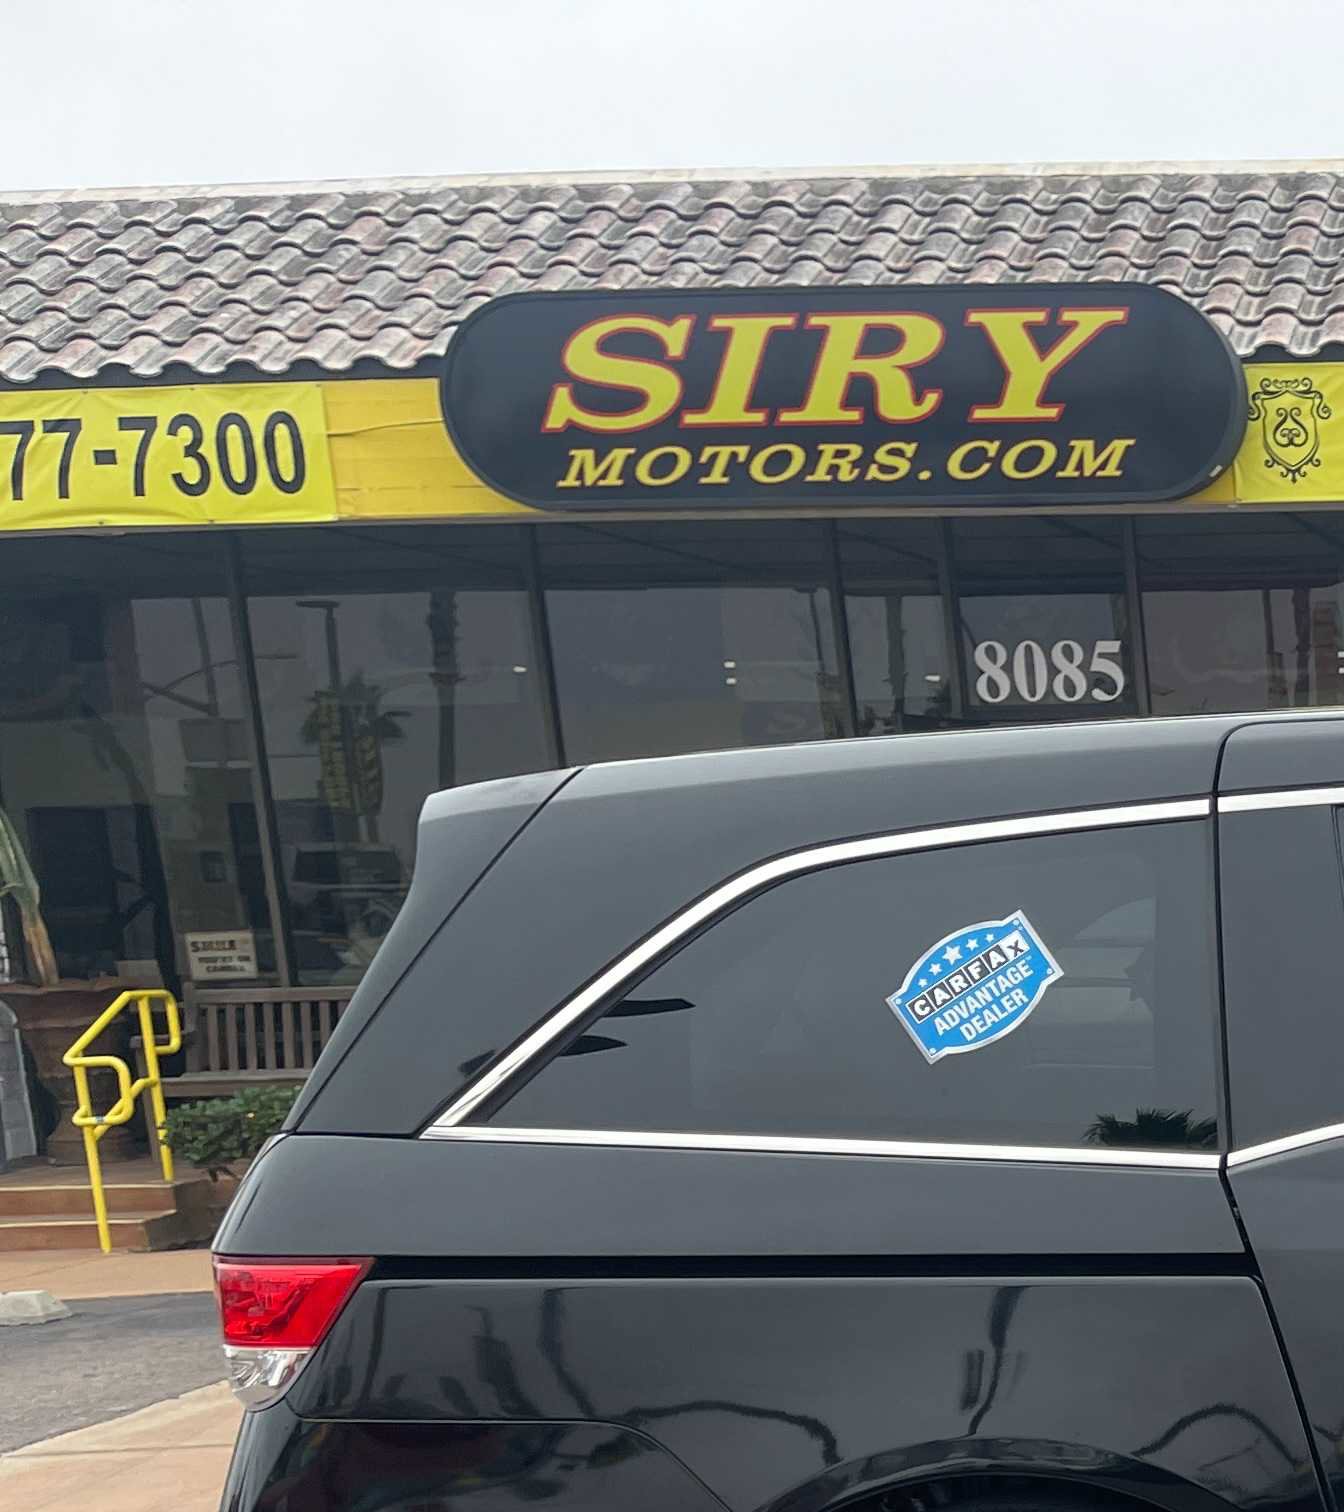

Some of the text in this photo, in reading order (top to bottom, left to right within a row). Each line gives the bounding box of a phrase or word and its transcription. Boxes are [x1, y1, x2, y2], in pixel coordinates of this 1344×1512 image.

[541, 307, 1128, 433] SIRY
[0, 411, 306, 500] 77-7300
[557, 439, 1136, 488] MOTORS.COM
[974, 640, 1126, 703] 8085
[911, 937, 1027, 1019] CARFAX
[933, 957, 1035, 1037] ADVANTAGE
[959, 987, 1029, 1042] DEALER
